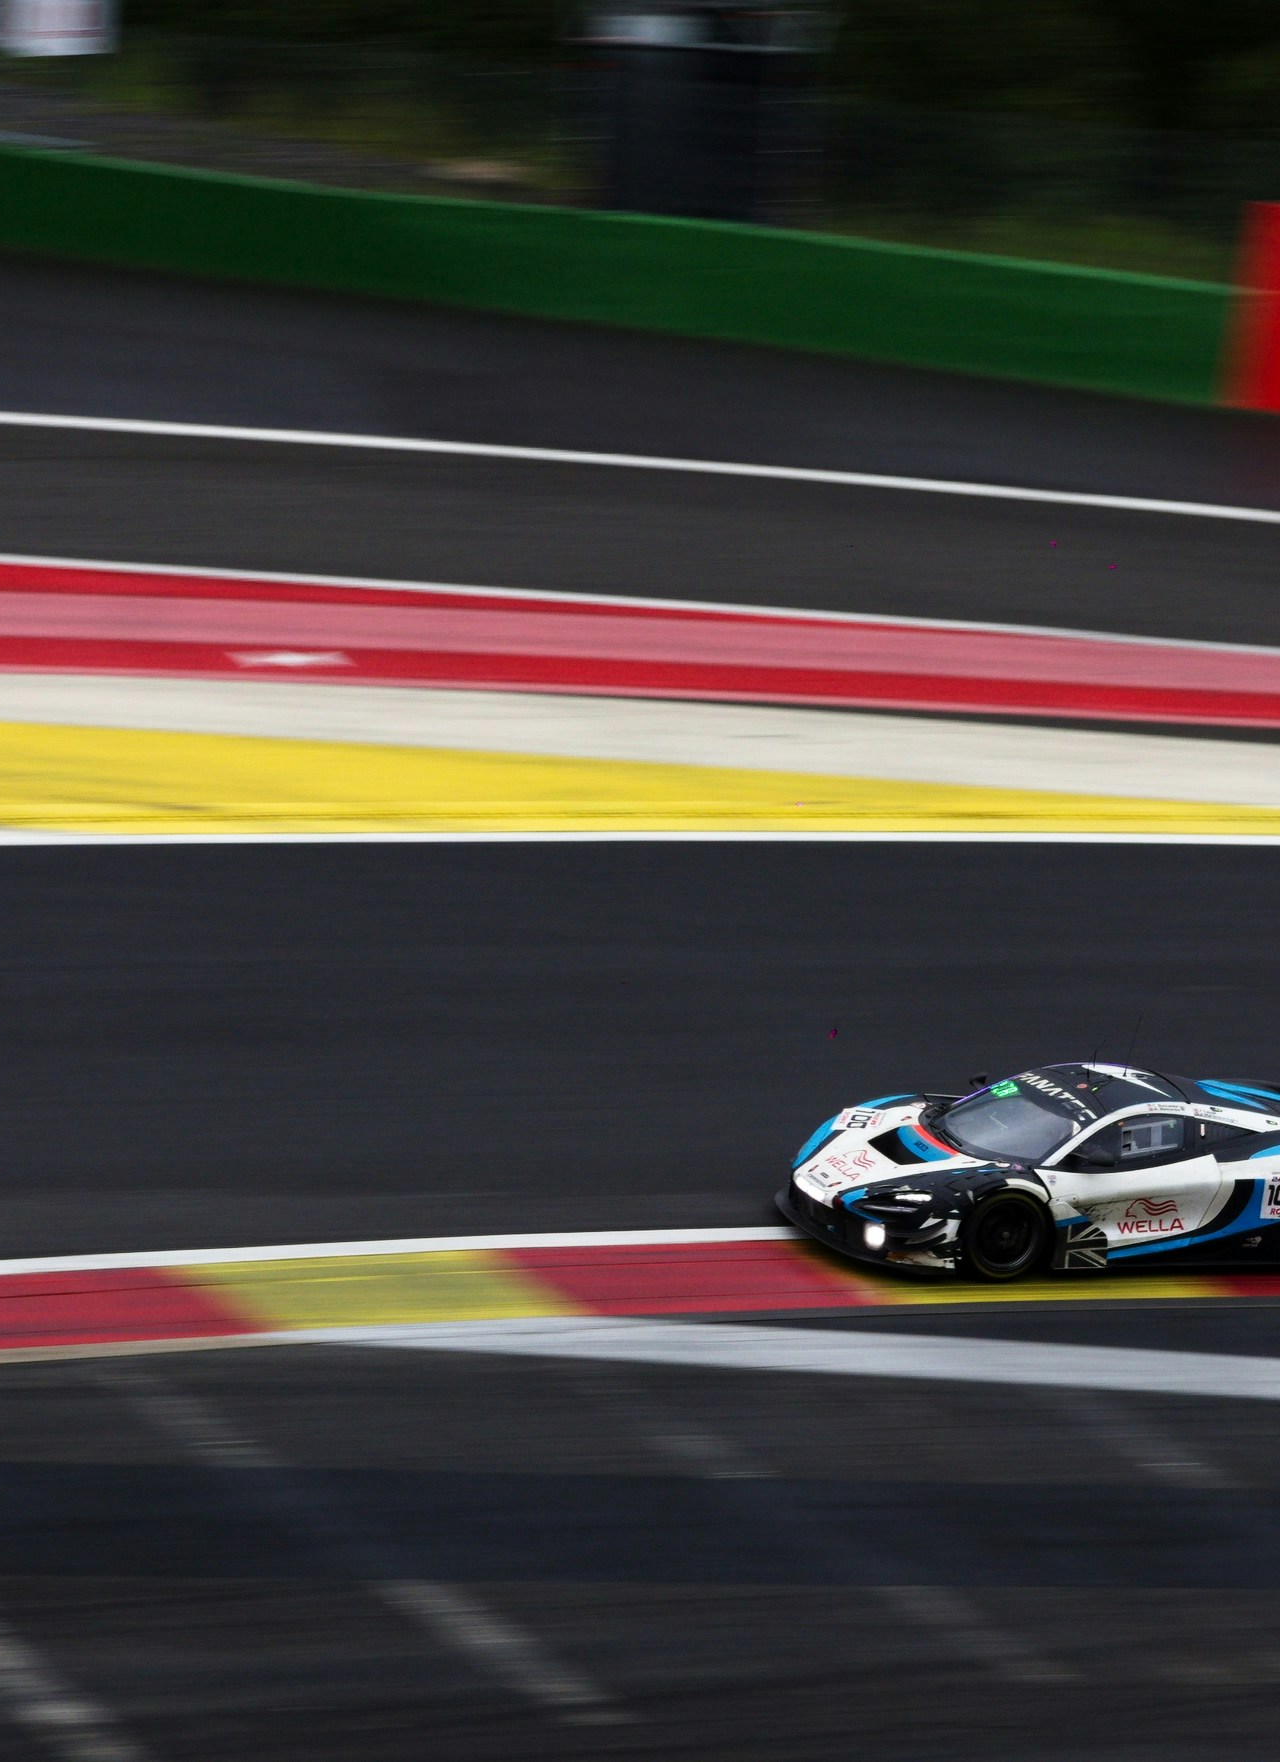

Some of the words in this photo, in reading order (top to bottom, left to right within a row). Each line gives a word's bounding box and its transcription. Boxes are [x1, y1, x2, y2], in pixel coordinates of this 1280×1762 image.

[846, 1109, 875, 1129] 100
[824, 1155, 861, 1182] WELLA
[1116, 1217, 1184, 1235] WELLA
